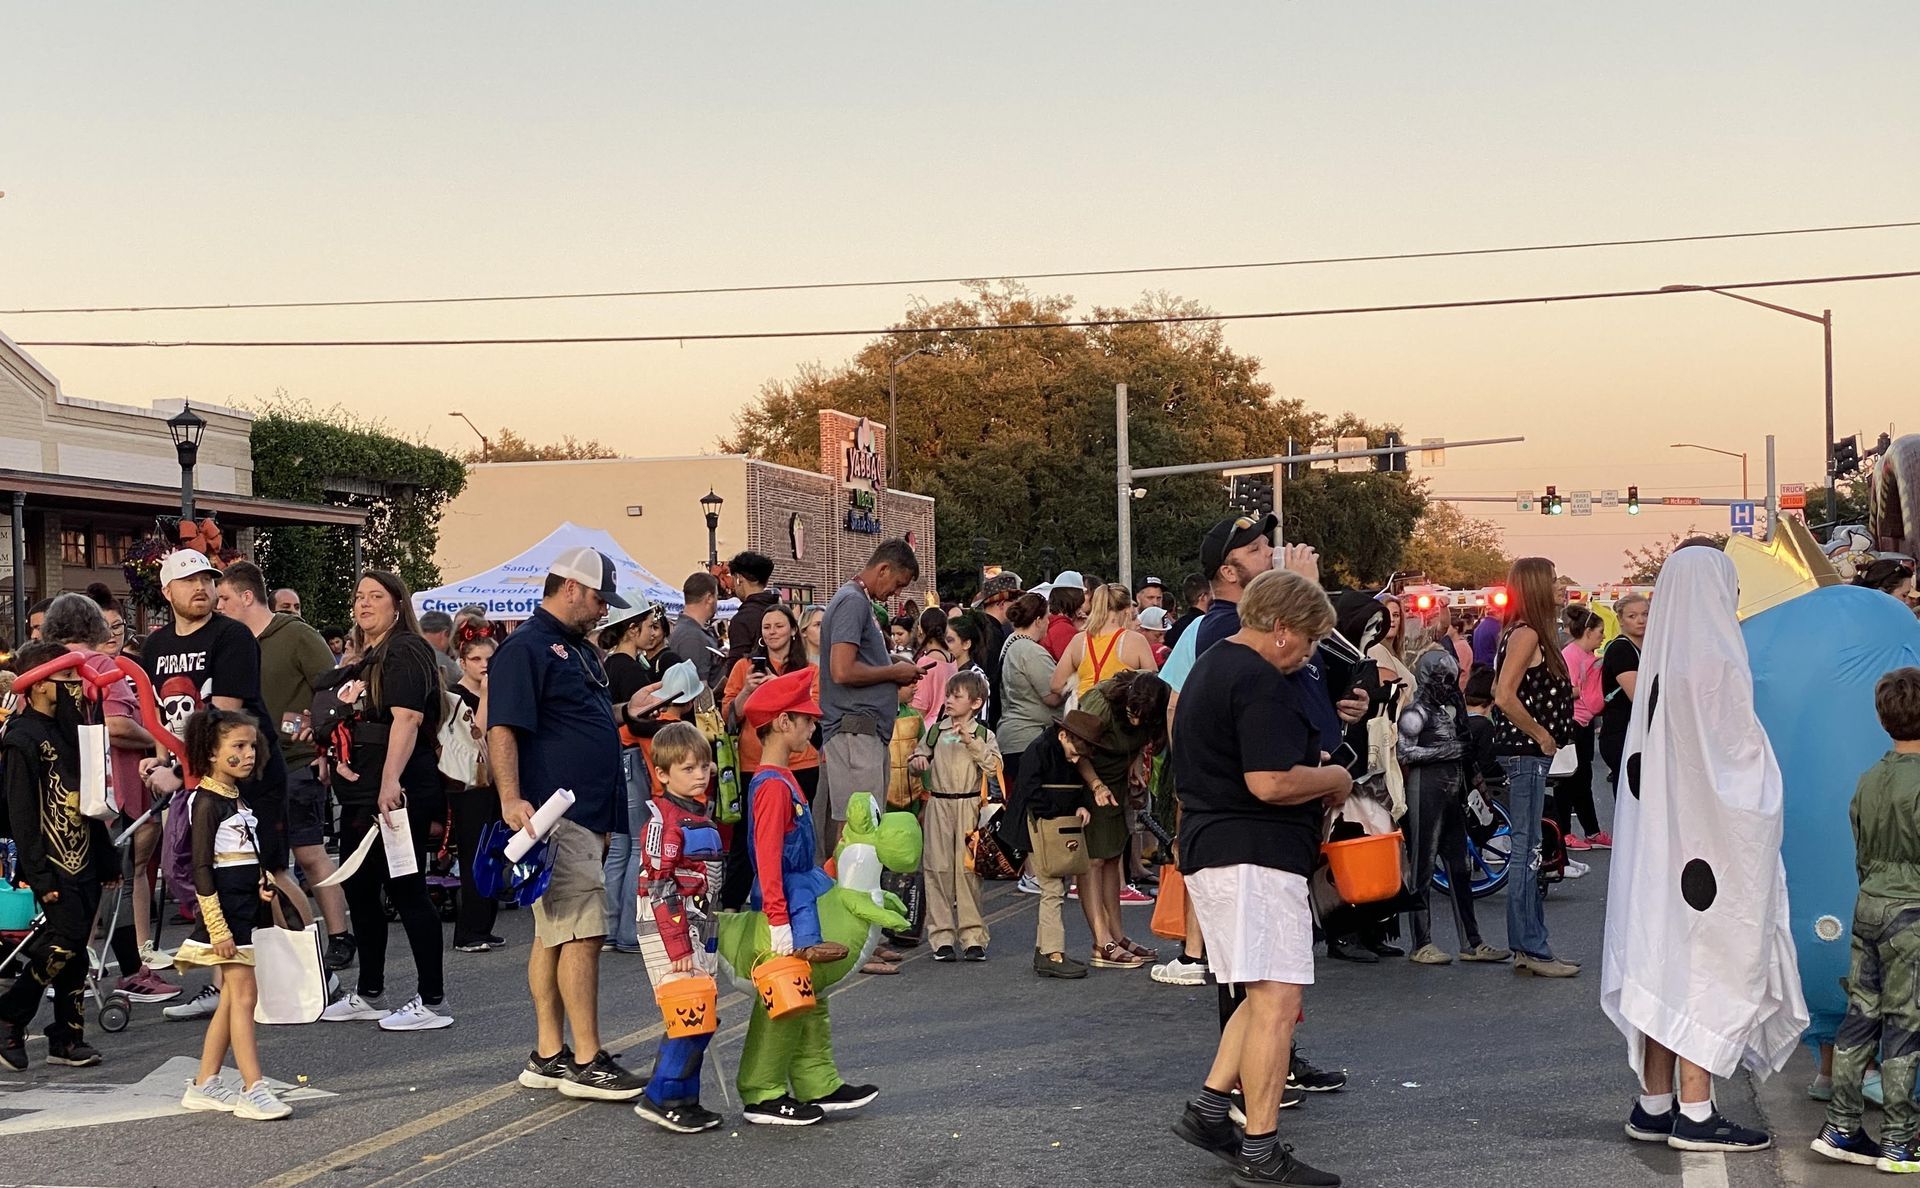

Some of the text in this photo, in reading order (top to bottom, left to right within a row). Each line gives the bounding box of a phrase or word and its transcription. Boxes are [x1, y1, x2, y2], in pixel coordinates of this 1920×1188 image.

[1735, 505, 1750, 524] H
[501, 564, 542, 574] Sandy
[458, 585, 540, 594] Chevrolet
[156, 651, 207, 675] PIRATE
